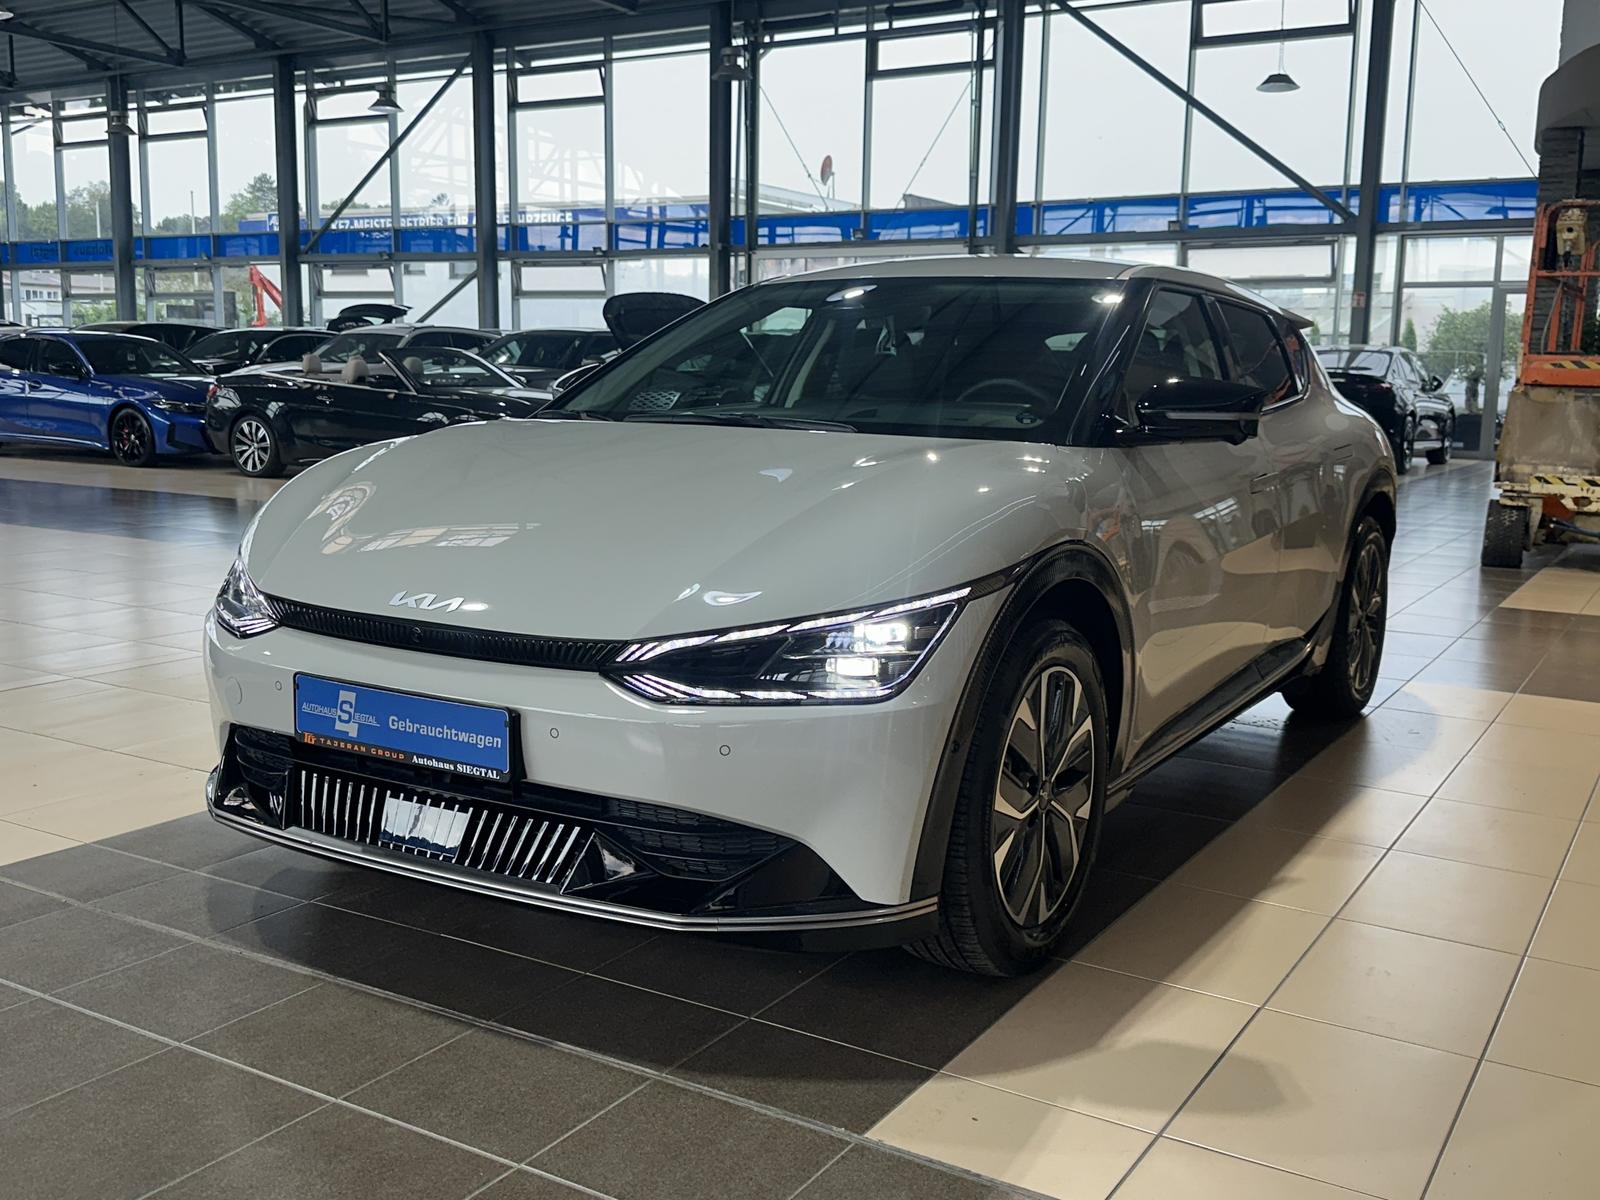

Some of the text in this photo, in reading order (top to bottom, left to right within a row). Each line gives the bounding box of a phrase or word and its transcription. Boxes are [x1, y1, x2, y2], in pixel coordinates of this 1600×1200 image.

[388, 590, 465, 613] KIA
[302, 702, 337, 716] AUTOHAUS
[388, 715, 502, 749] Gebrauchtwagen
[412, 754, 500, 779] Autohaus SIEGTAL
